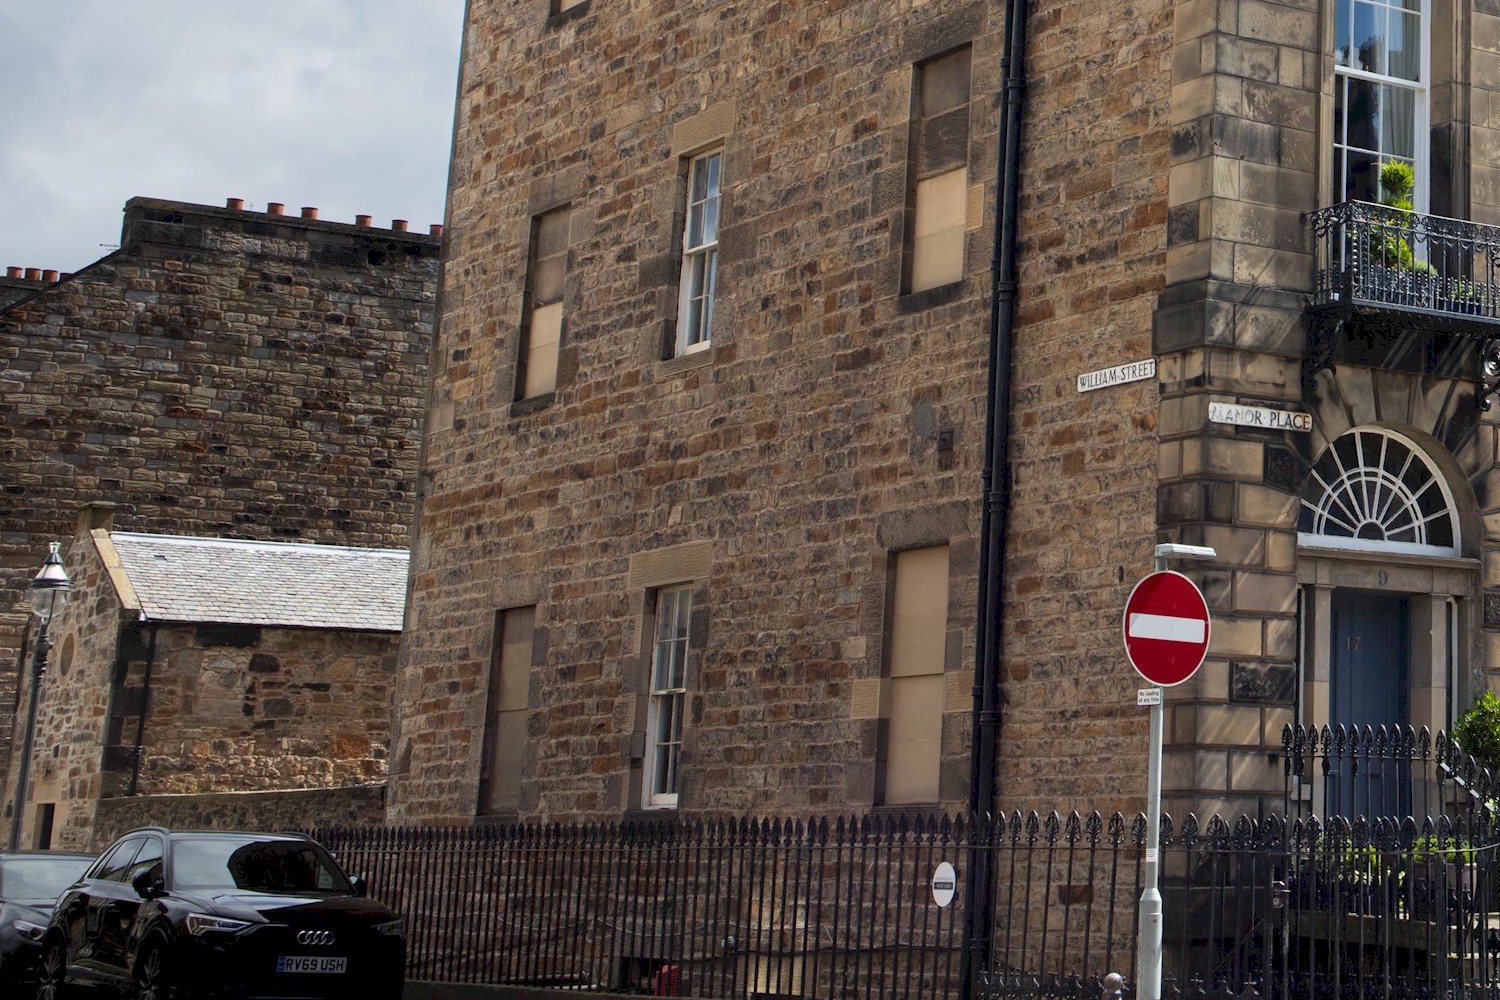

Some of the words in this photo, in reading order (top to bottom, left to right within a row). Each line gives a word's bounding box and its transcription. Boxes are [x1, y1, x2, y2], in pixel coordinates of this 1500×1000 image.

[1080, 369, 1117, 388] WILLIAM
[1121, 361, 1154, 380] STREET
[1211, 406, 1263, 425] MANOR
[1270, 411, 1311, 430] PLACE
[1378, 570, 1388, 586] 9
[1345, 637, 1361, 651] 17
[286, 958, 318, 971] RV69
[320, 959, 344, 971] USH
